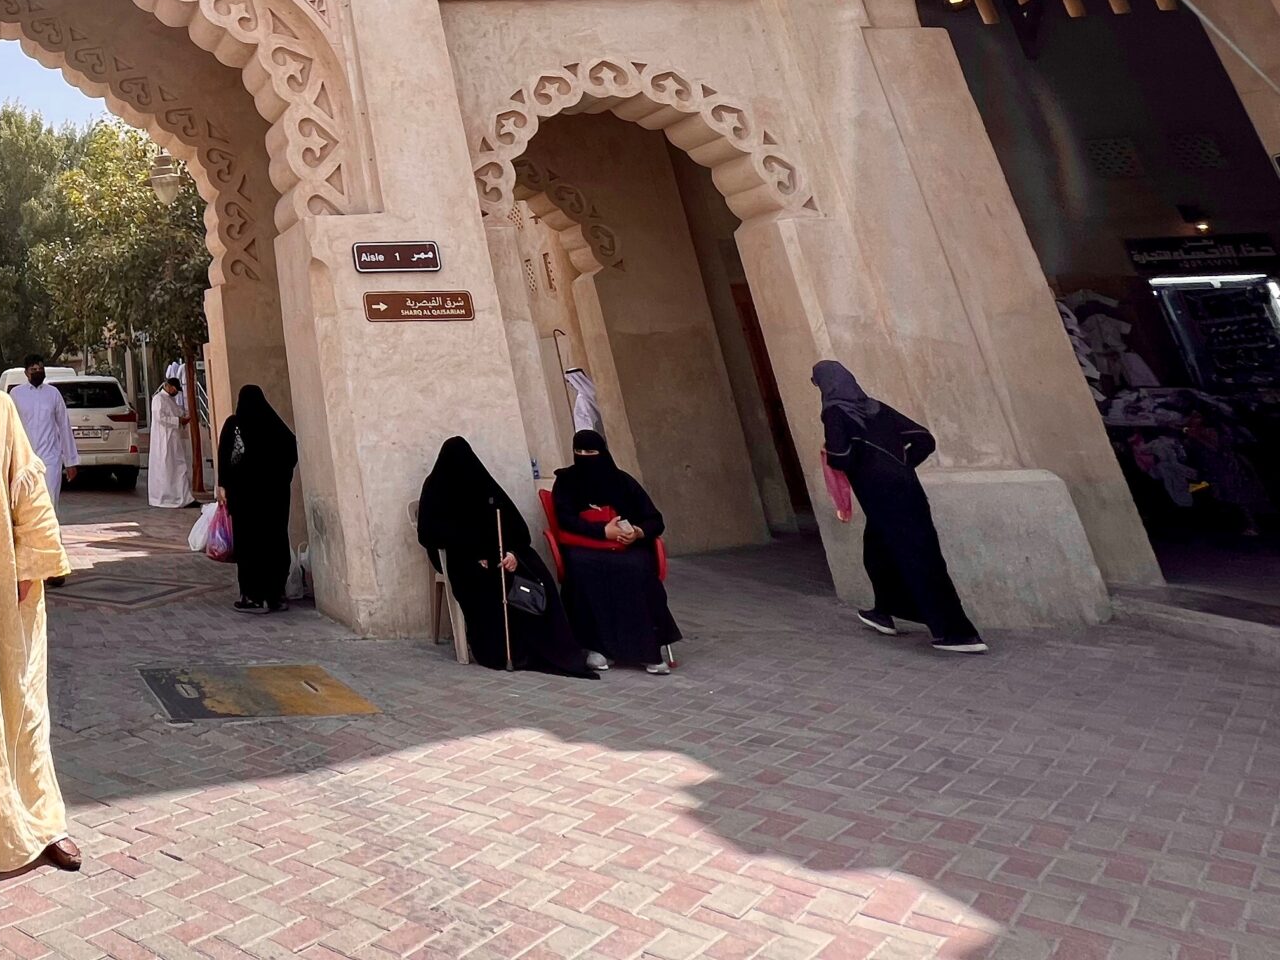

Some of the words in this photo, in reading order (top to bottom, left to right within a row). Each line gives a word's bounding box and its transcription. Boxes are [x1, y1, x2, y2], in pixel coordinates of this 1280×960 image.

[361, 252, 385, 262] Aisle
[394, 252, 401, 261] 1
[411, 250, 434, 261] ممر
[405, 296, 443, 309] القيصرية
[444, 296, 464, 308] شرق
